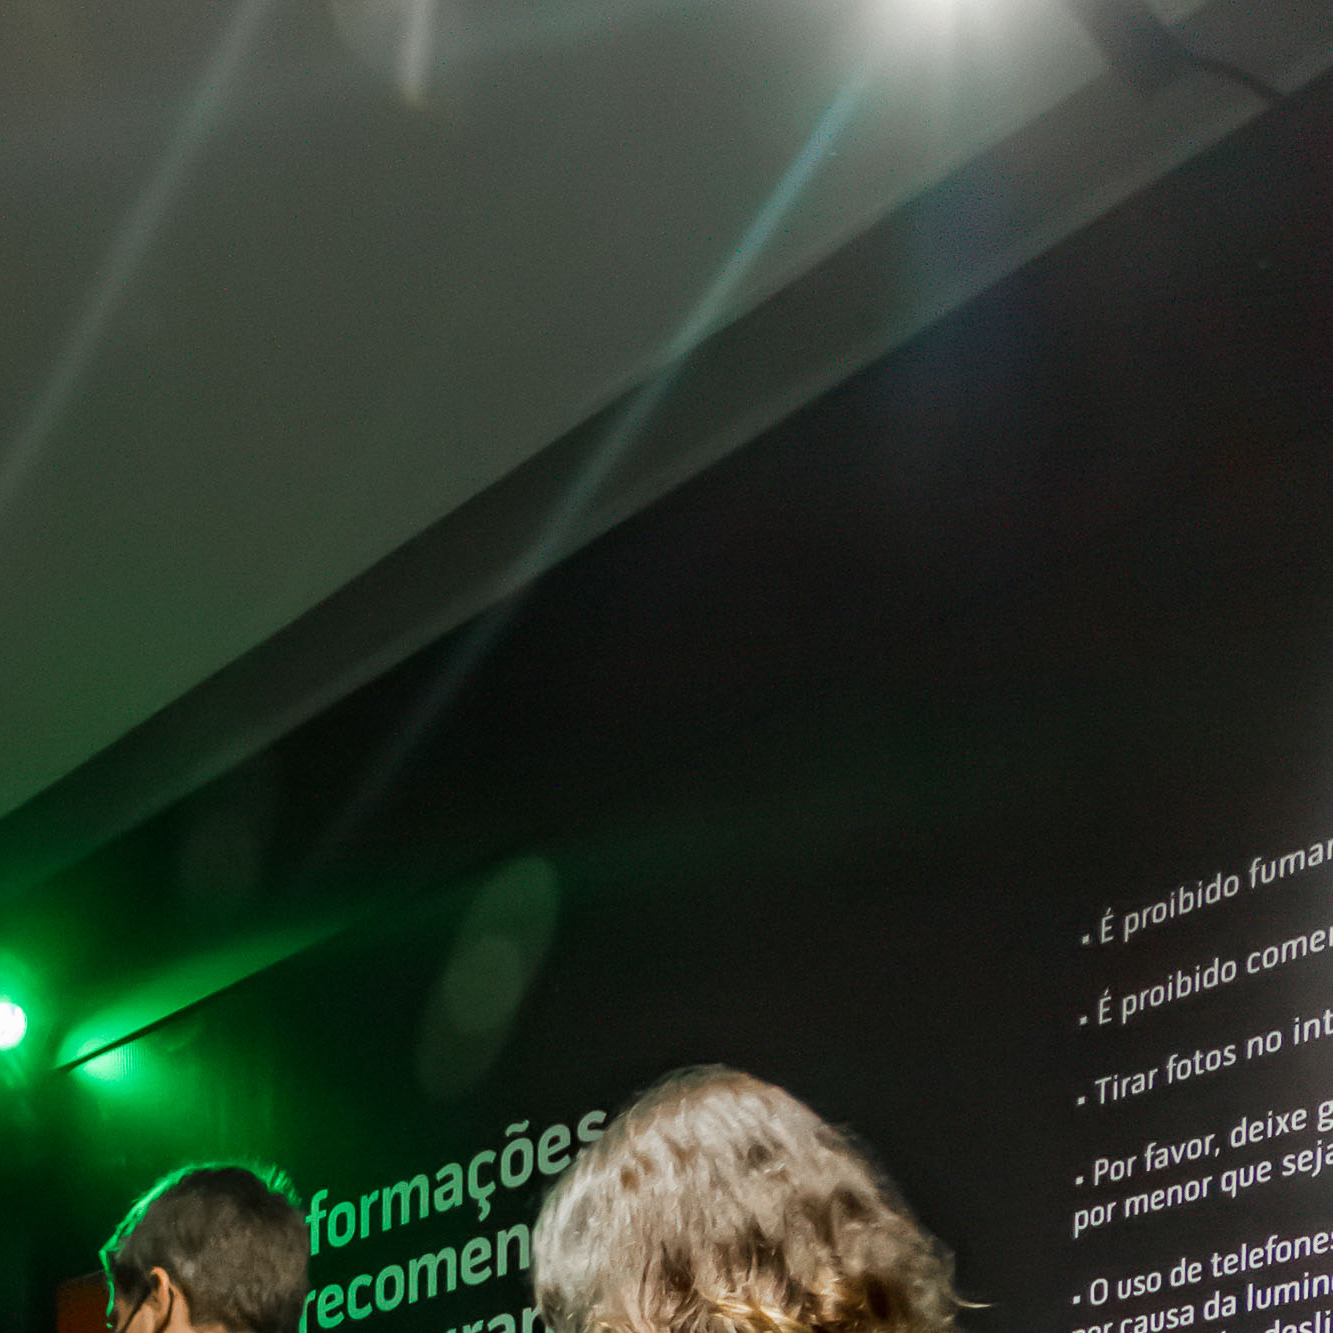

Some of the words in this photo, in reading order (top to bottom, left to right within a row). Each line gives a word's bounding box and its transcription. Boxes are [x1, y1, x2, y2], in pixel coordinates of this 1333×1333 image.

[1099, 907, 1114, 943] É
[1123, 873, 1239, 942] proibido
[1098, 987, 1112, 1025] É
[1122, 958, 1237, 1024] proibido
[1095, 1068, 1158, 1104] Tirar
[1167, 1044, 1236, 1084] fotos
[1247, 1031, 1282, 1059] no
[1094, 1156, 1137, 1186] Por
[1144, 1133, 1220, 1171] favor,
[1230, 1108, 1307, 1148] deixe
[1073, 1202, 1116, 1239] por
[1124, 1176, 1213, 1217] menor
[1220, 1160, 1272, 1198] que
[1090, 1278, 1108, 1306] O
[1117, 1271, 1161, 1299] uso
[1170, 1257, 1202, 1287] de
[1203, 1290, 1236, 1320] da
[1247, 1272, 1333, 1311] lumin
